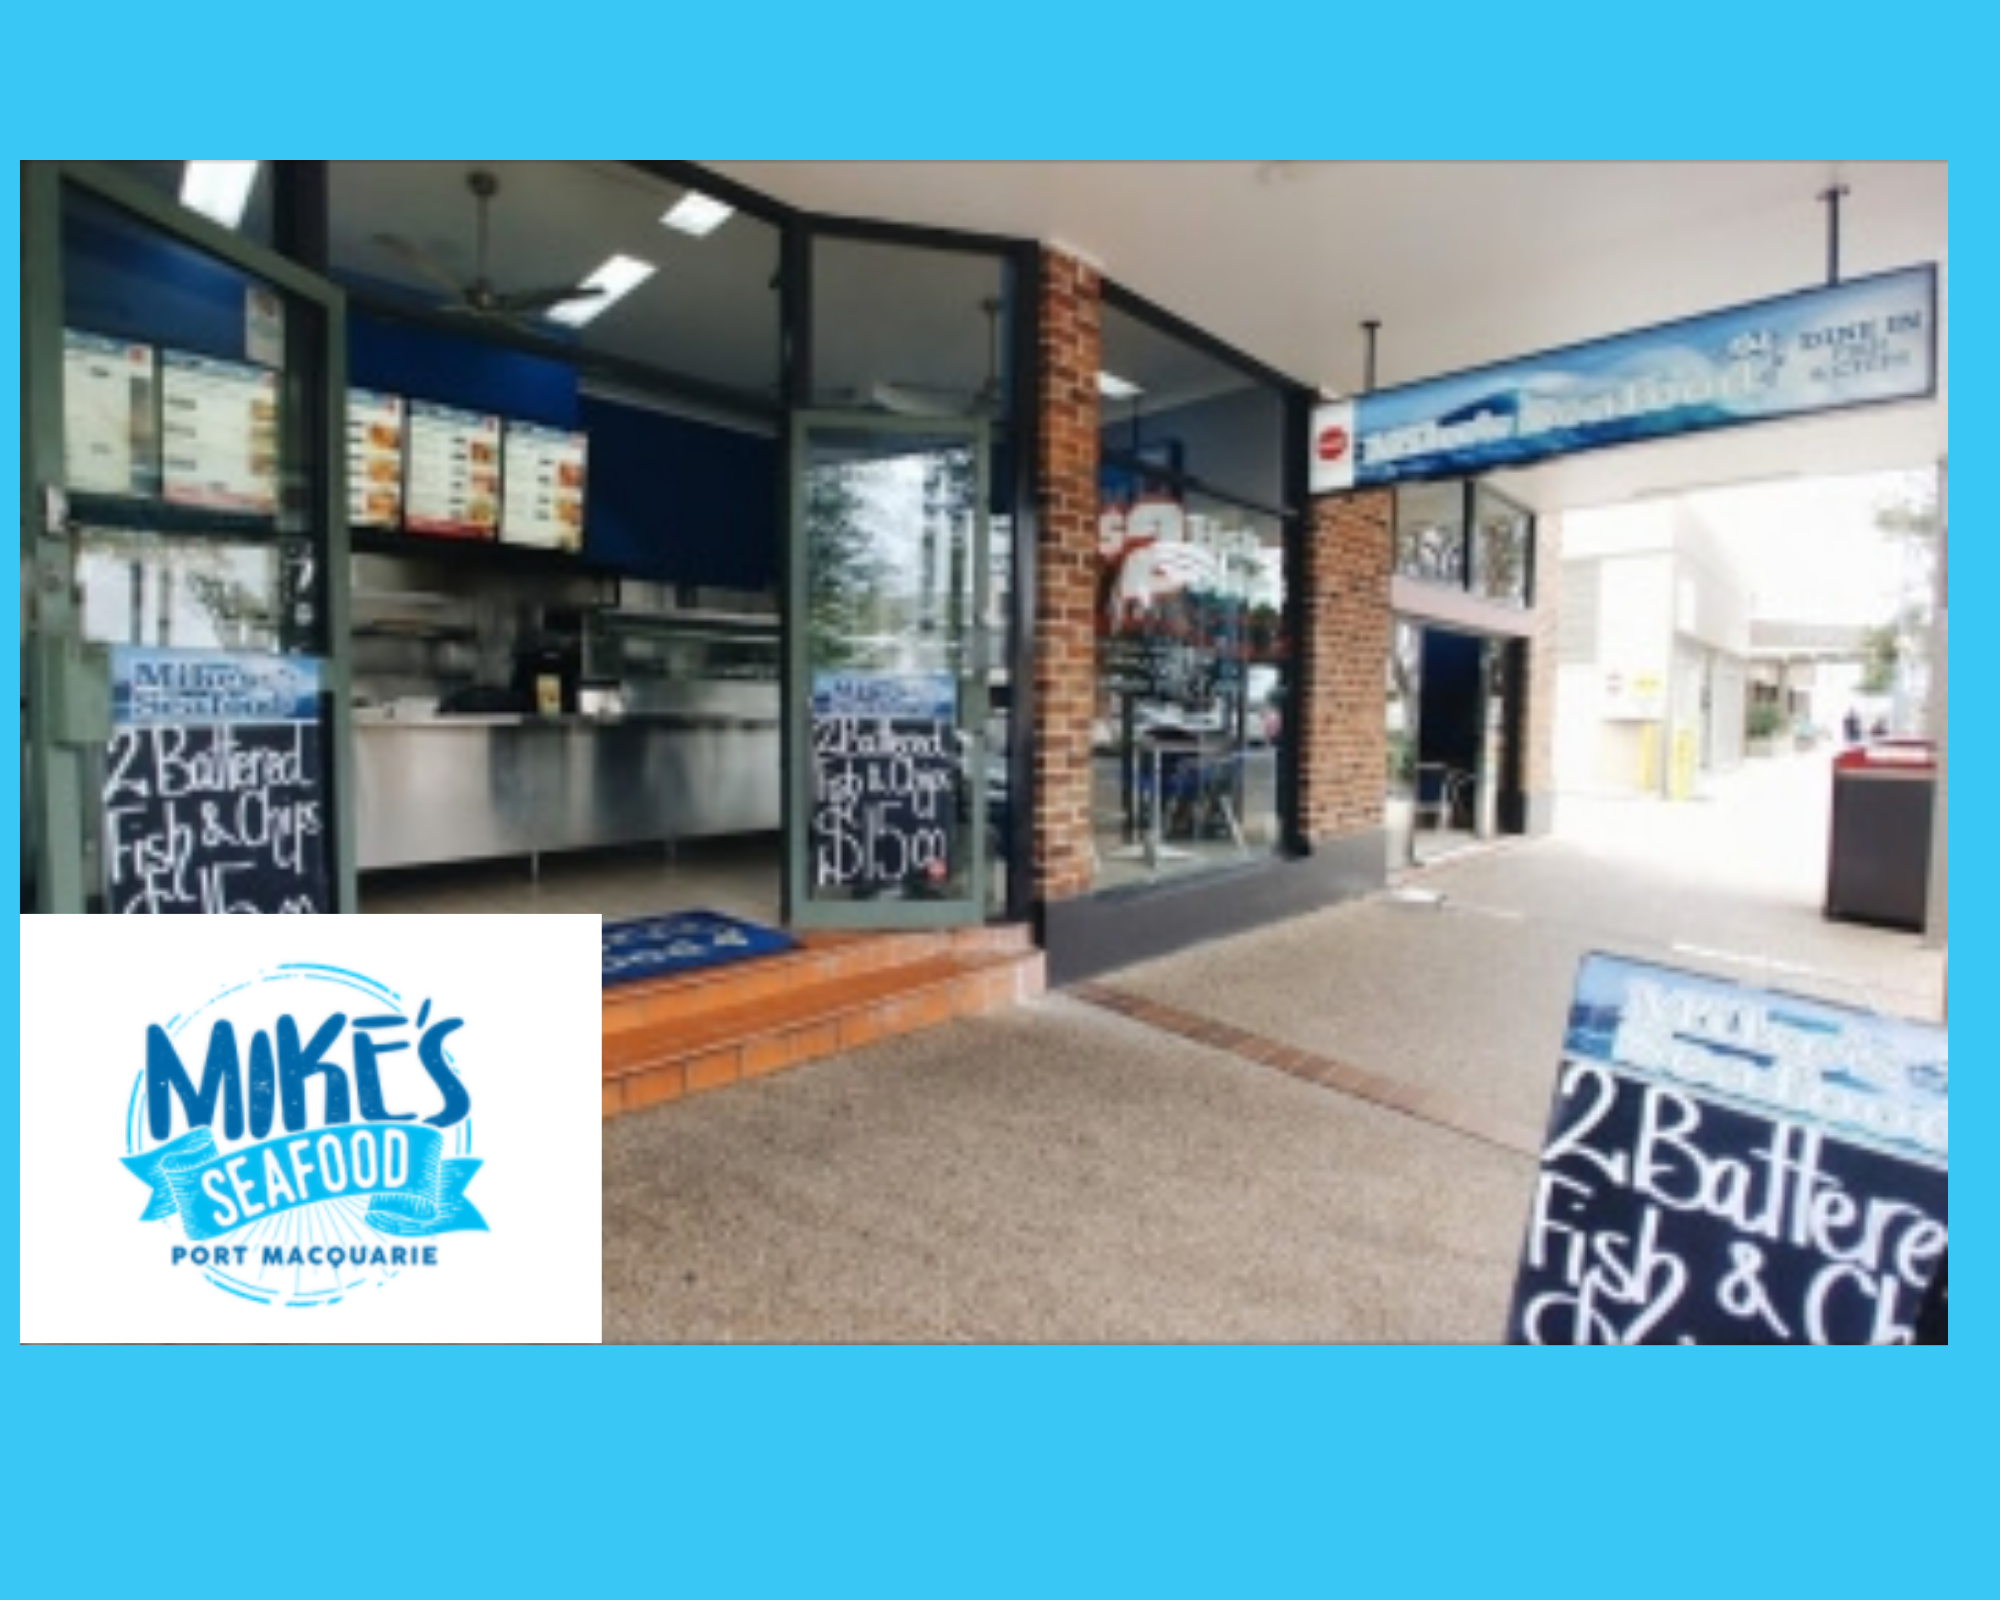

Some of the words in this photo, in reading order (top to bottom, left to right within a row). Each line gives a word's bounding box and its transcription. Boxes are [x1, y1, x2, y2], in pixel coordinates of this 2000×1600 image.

[102, 725, 149, 803] 2
[152, 724, 315, 798] Battered
[106, 800, 193, 884] Fish
[201, 800, 241, 847] &
[1540, 1065, 1630, 1186] 2
[1529, 1171, 1687, 1318] Fish
[1716, 1239, 1792, 1339] &
